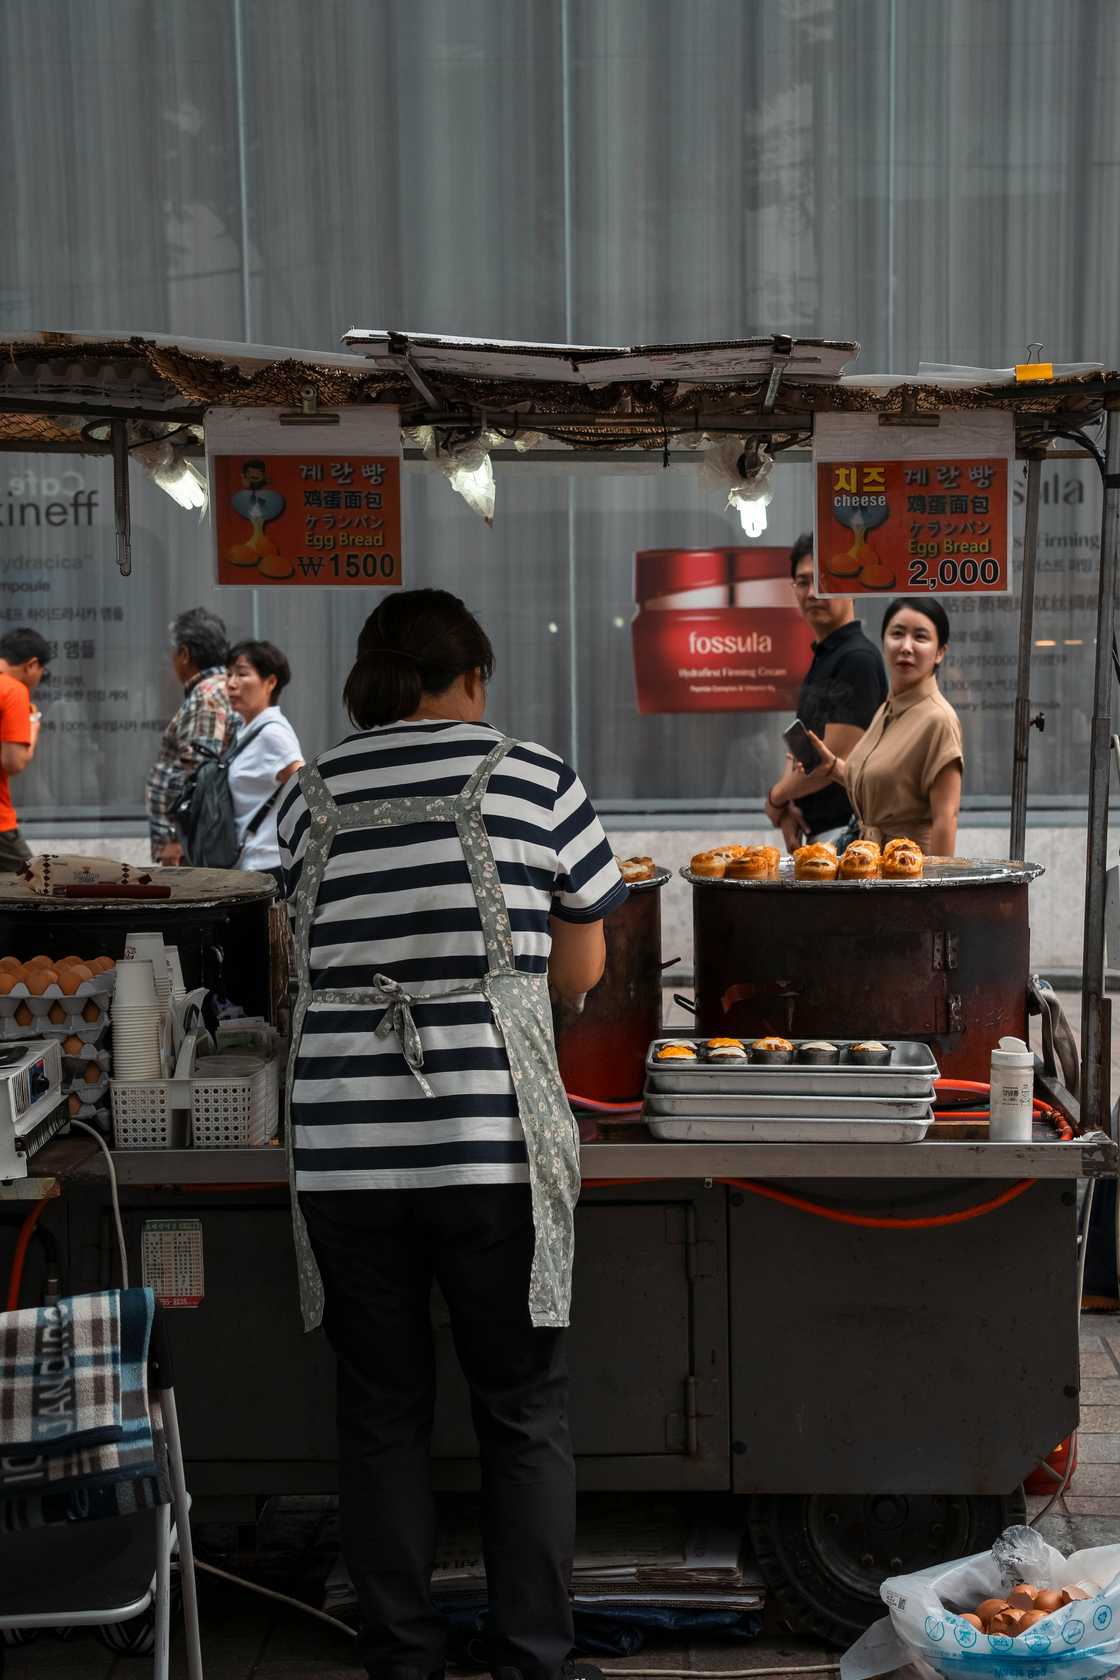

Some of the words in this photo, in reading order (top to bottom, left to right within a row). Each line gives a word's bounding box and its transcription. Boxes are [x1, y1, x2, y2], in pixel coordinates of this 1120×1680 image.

[833, 467, 887, 494] 치즈
[0, 490, 98, 527] ineff
[833, 494, 887, 507] cheese
[305, 531, 335, 550] Egg
[339, 530, 384, 548] Bread
[908, 540, 938, 558] Egg
[943, 537, 991, 554] Bread
[1037, 531, 1100, 550] irming
[907, 558, 1001, 591] 2,000
[688, 631, 772, 655] fossula
